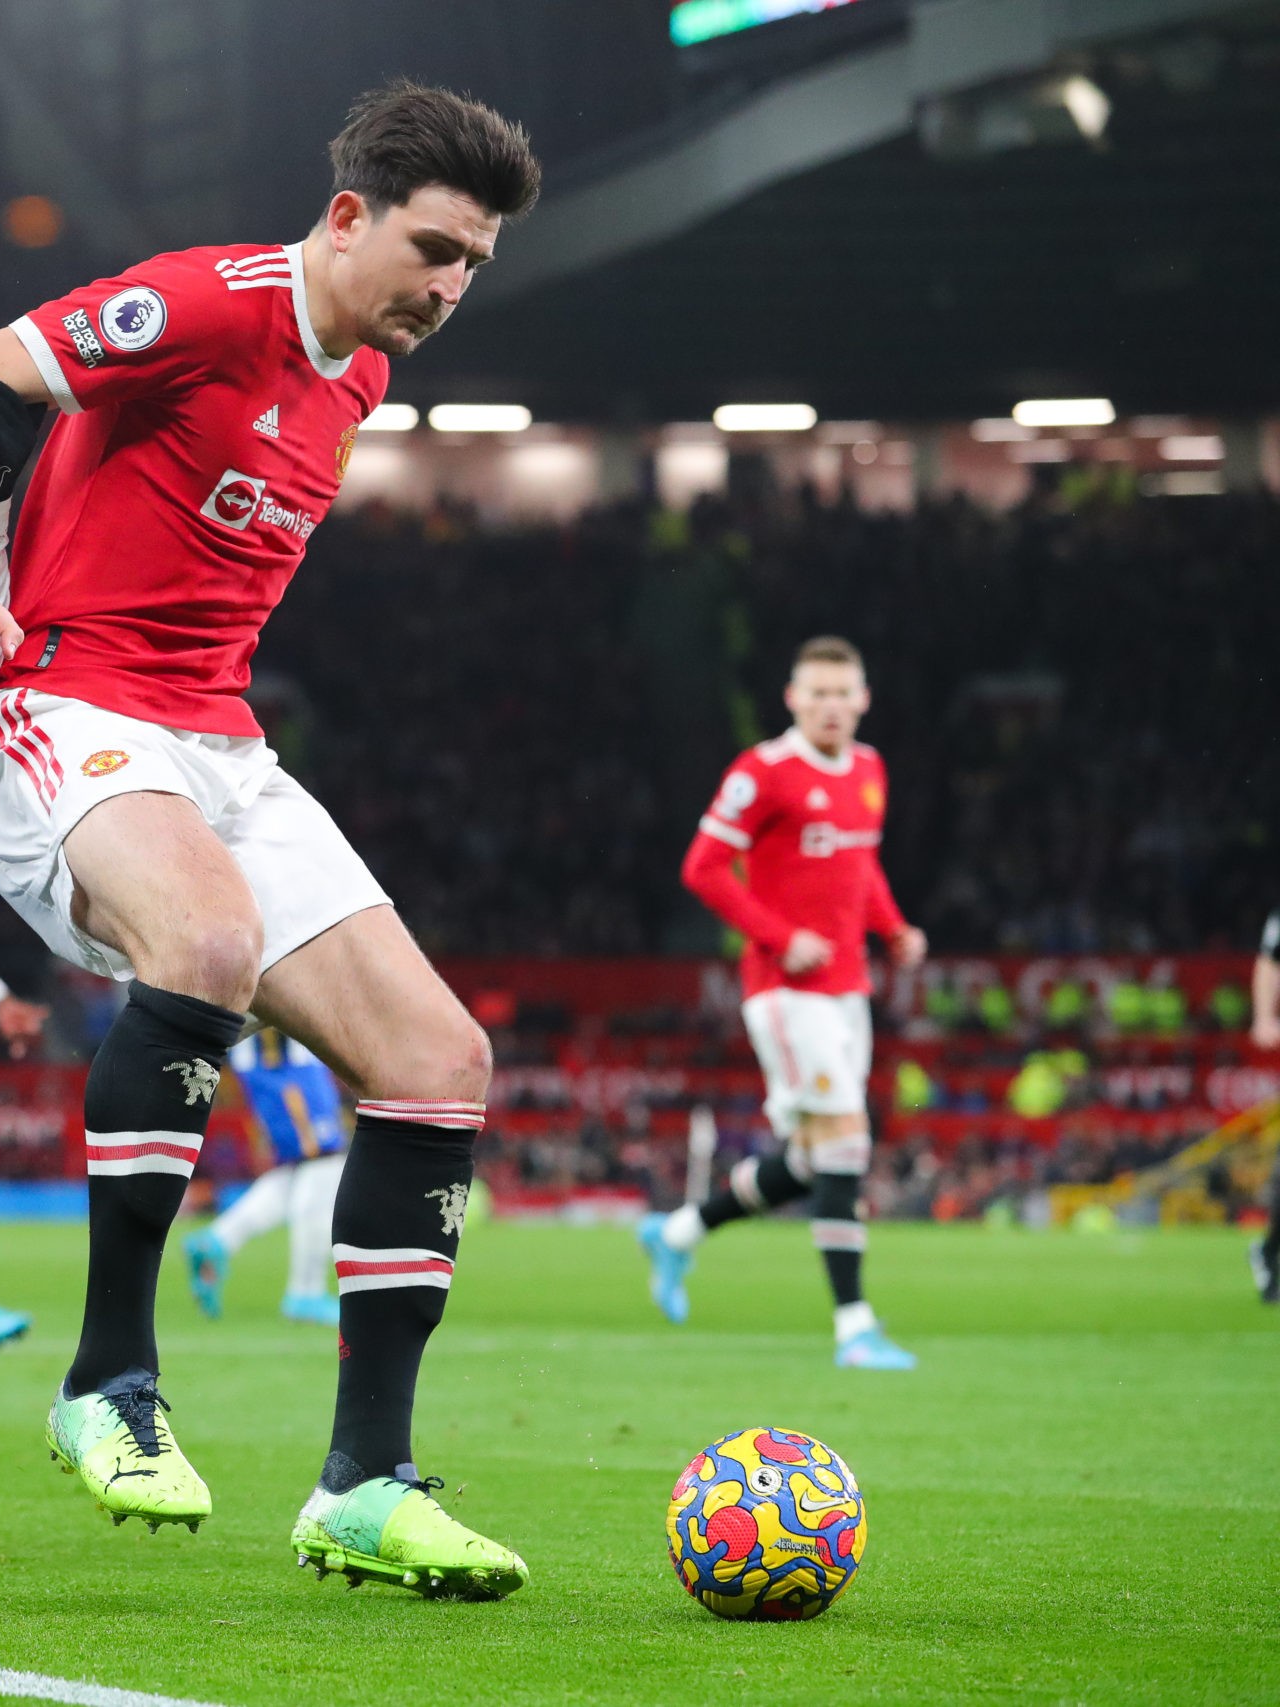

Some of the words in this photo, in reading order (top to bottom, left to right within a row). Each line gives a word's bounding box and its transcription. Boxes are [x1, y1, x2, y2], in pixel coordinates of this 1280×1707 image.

[70, 331, 97, 369] racism
[81, 327, 104, 359] room
[253, 420, 280, 439] adidas
